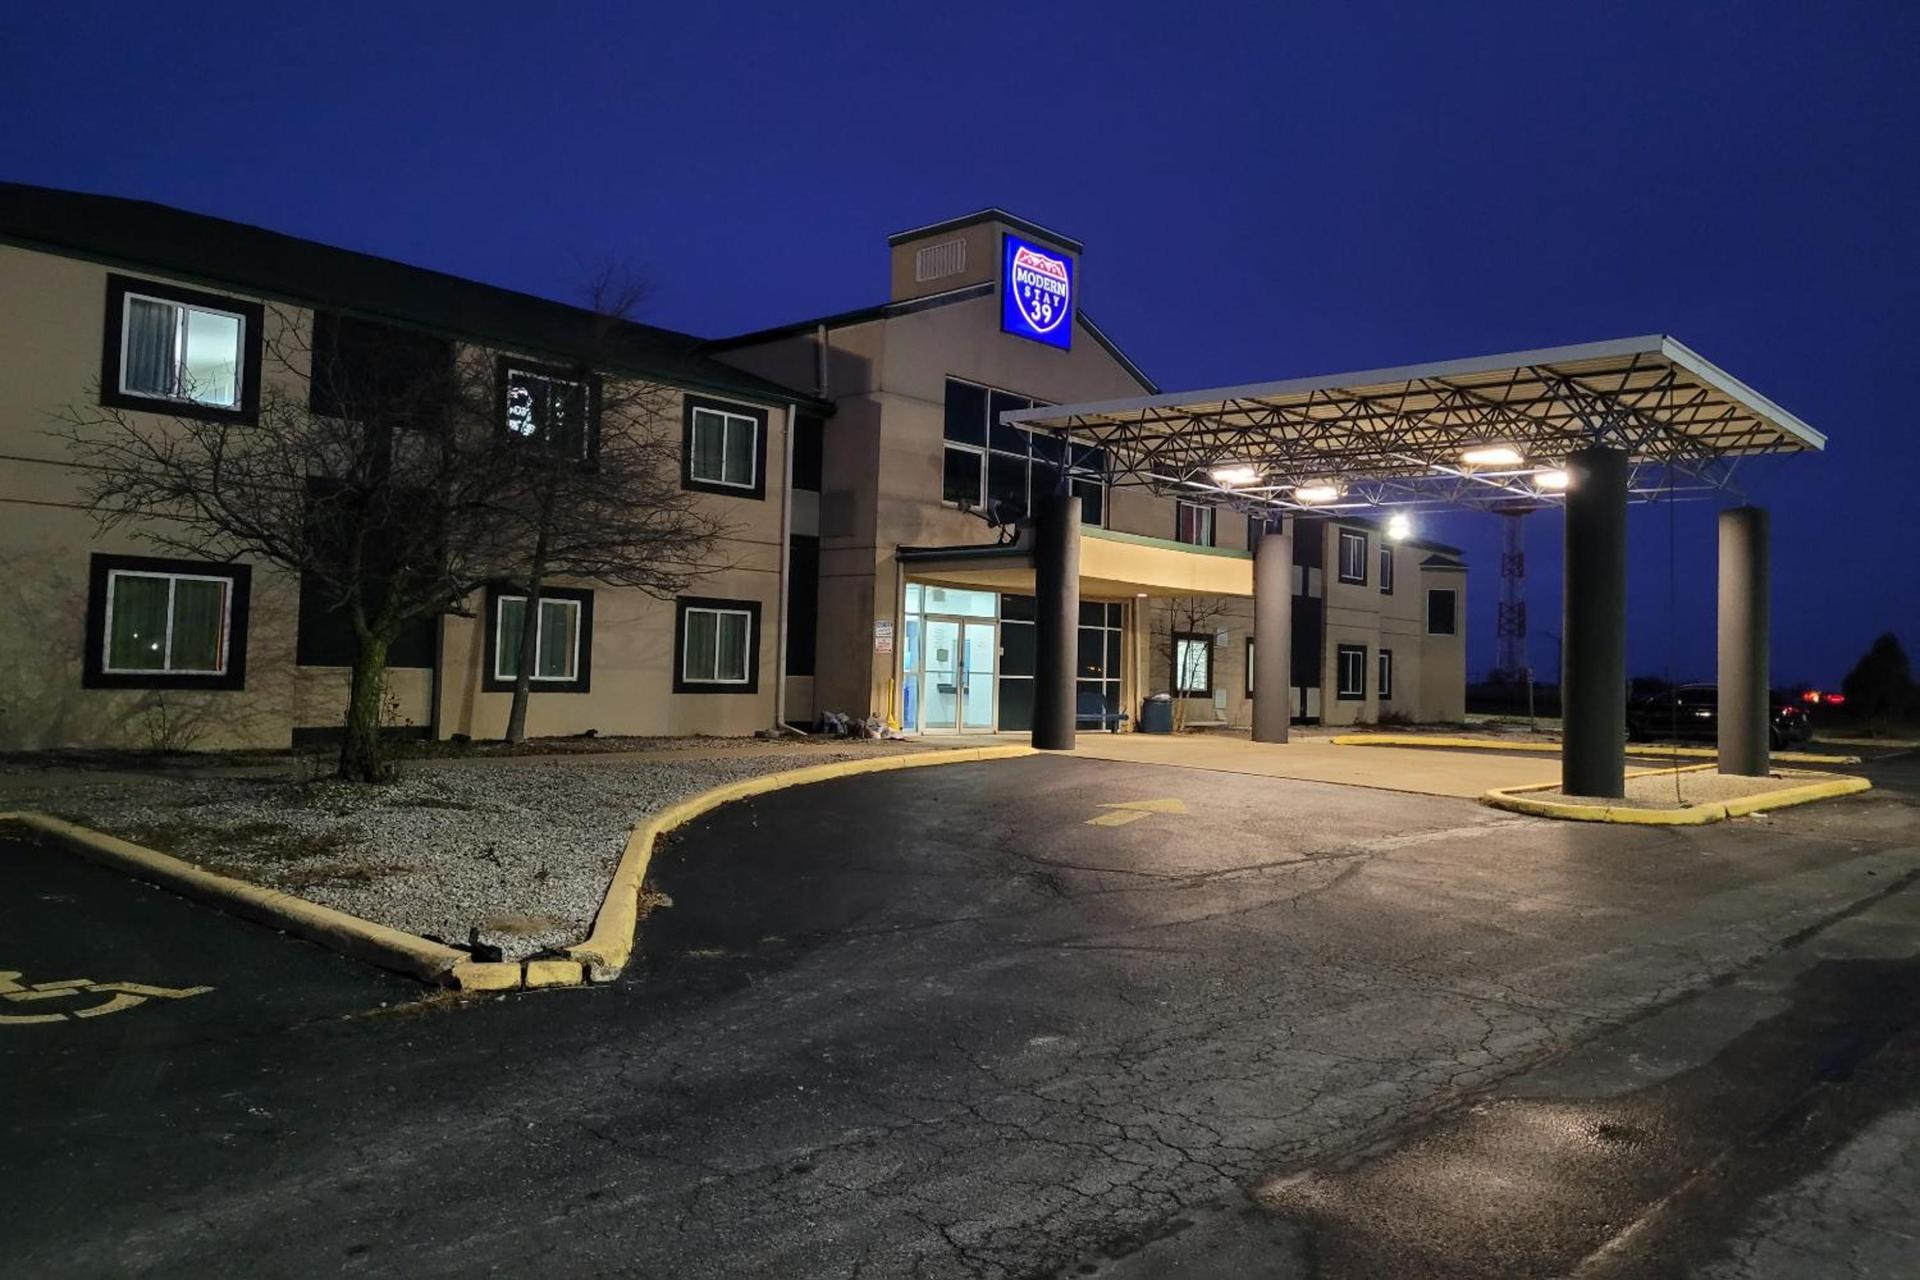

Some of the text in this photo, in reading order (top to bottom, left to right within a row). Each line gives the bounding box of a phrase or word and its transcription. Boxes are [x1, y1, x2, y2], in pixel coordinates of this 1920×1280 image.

[1017, 267, 1066, 298] MODERN
[1024, 286, 1060, 307] STAY
[1031, 300, 1052, 324] 39
